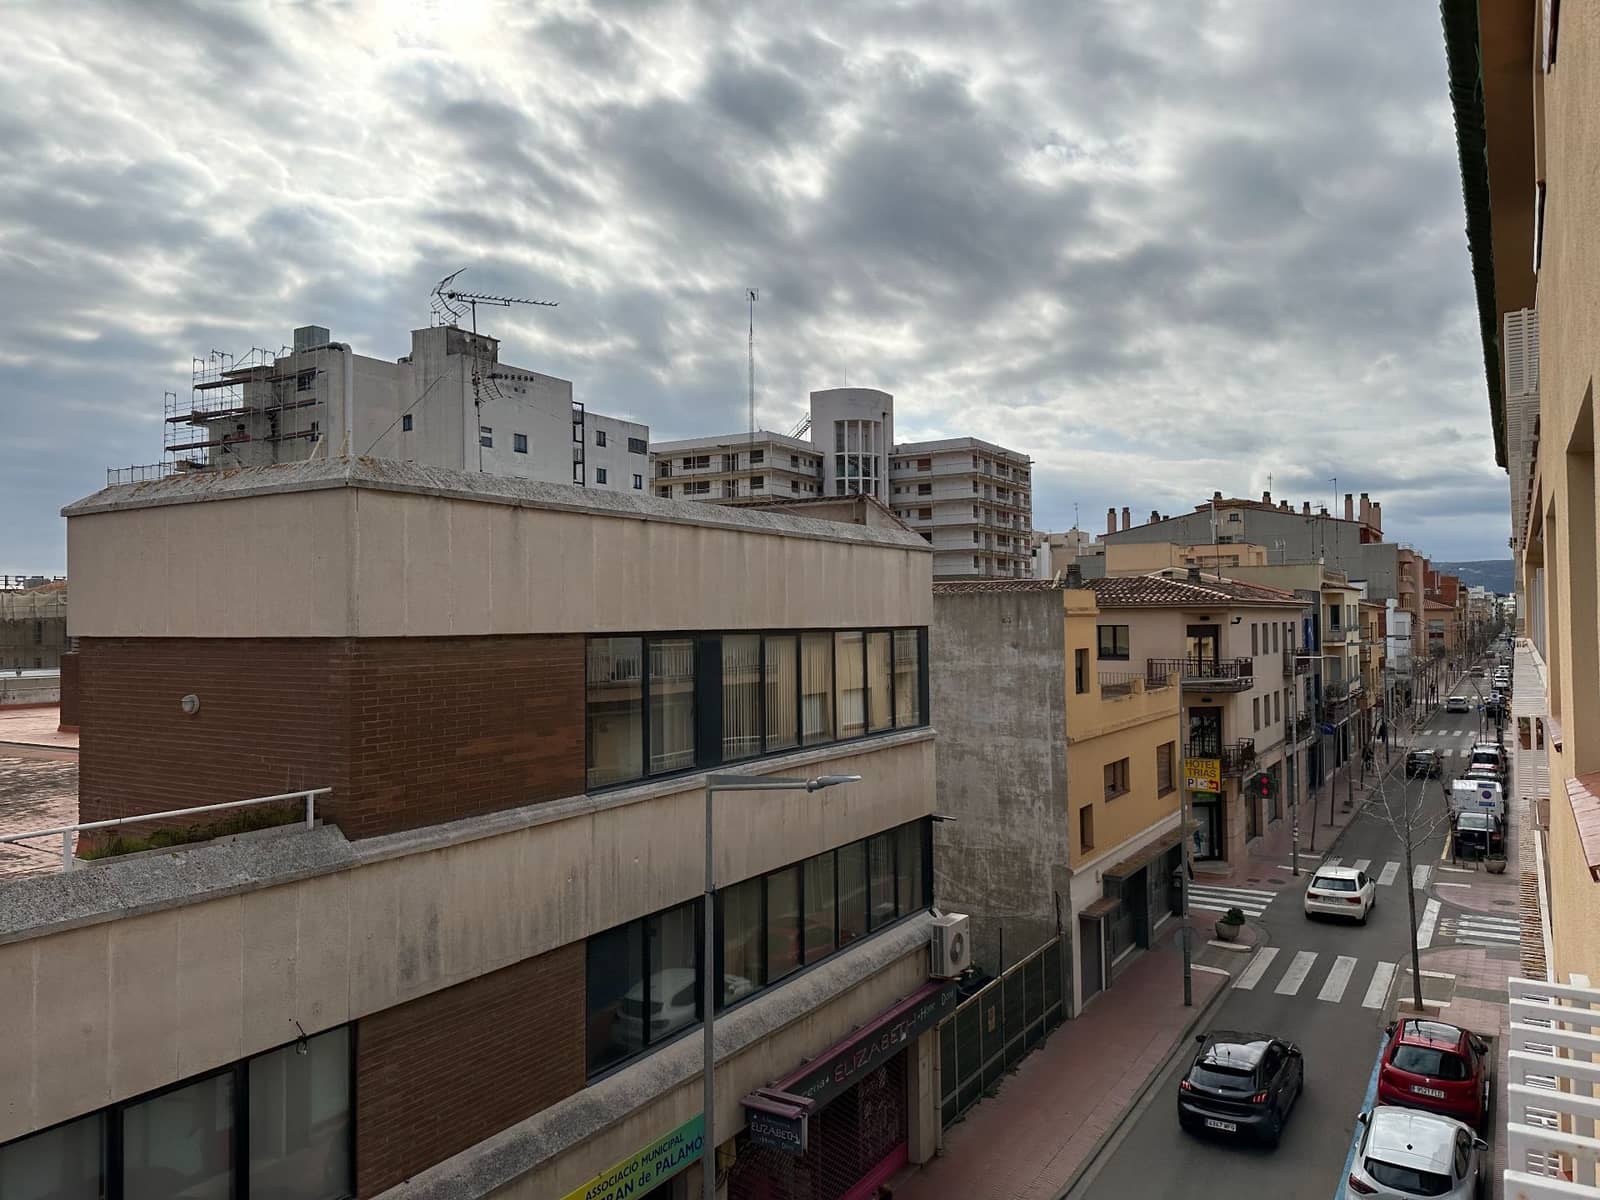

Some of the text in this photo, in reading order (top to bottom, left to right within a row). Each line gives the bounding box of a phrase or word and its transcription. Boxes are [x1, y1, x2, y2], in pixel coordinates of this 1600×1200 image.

[1185, 759, 1216, 769] HOTEL
[1187, 768, 1216, 777] TRIAS
[641, 1132, 684, 1167] MUNICIPAL
[601, 1178, 634, 1200] RAN
[638, 1171, 652, 1187] de
